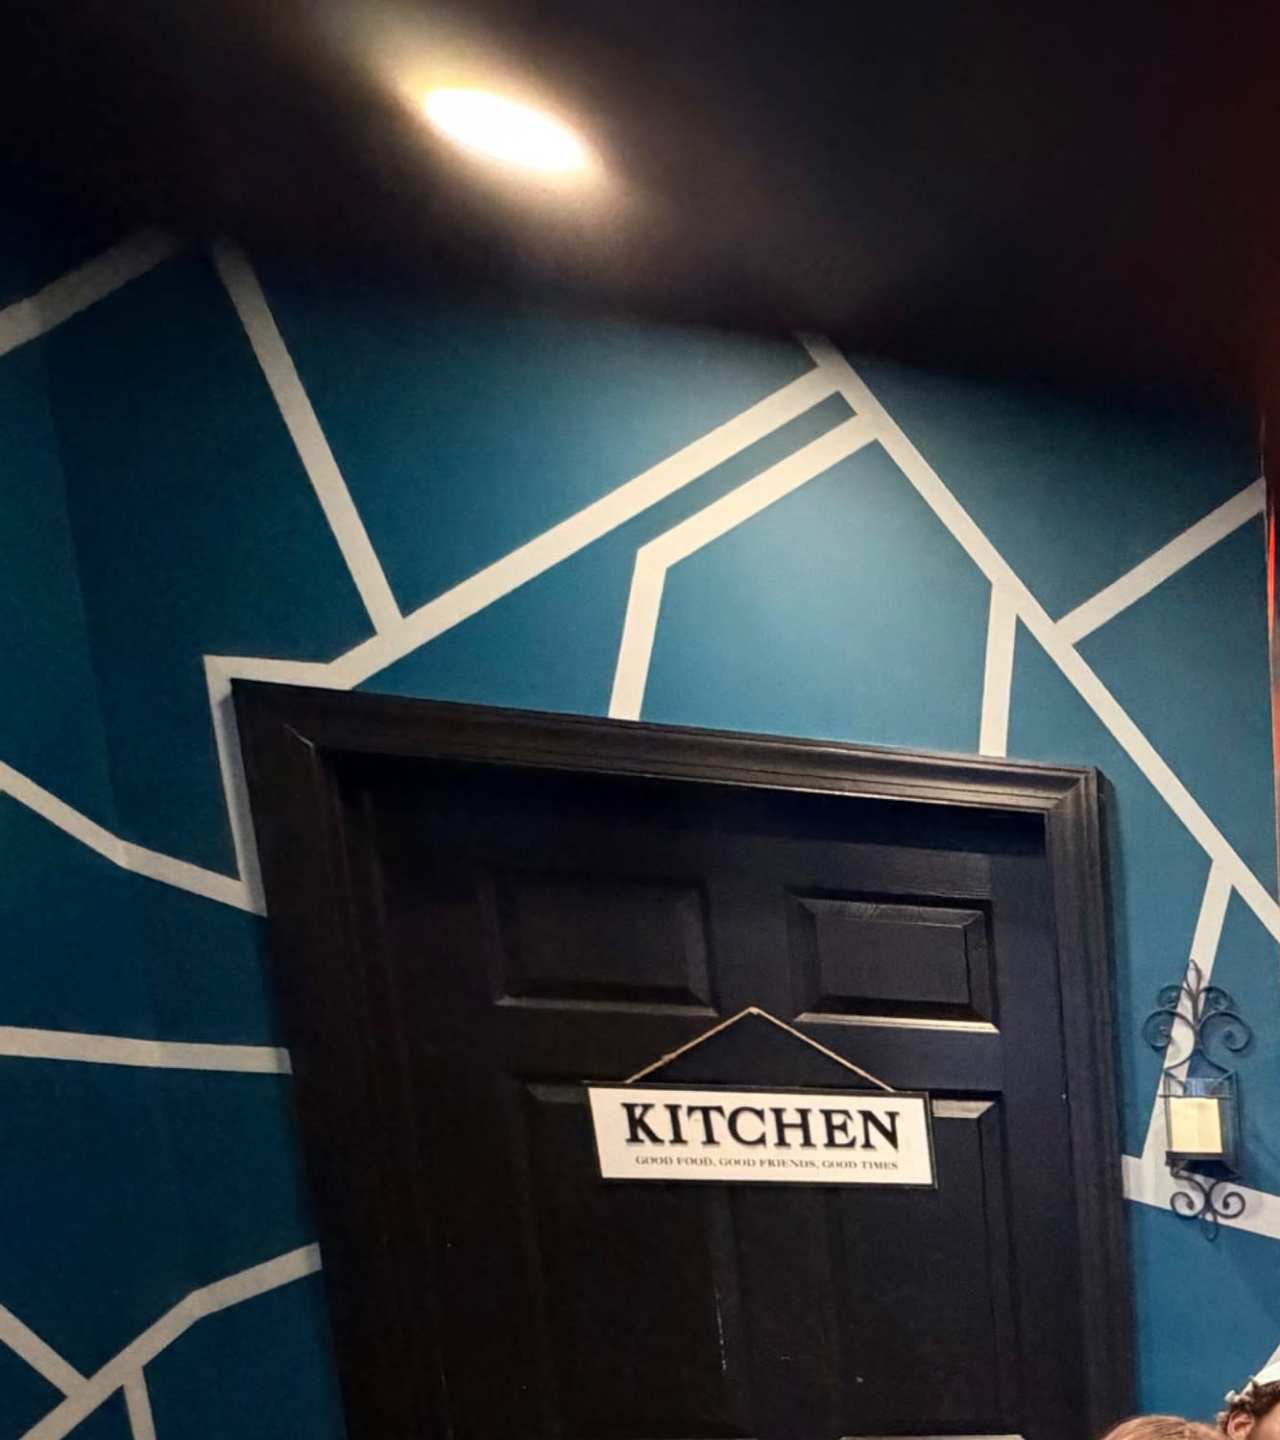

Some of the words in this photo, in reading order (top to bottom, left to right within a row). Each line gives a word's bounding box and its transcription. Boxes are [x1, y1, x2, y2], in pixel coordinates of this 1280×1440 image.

[621, 1102, 901, 1152] KITCHEN
[635, 1154, 674, 1167] GOOD
[676, 1155, 717, 1168] FOOD,
[719, 1157, 757, 1169] GOOD
[822, 1159, 858, 1170] GOOD
[861, 1160, 899, 1171] TIMES
